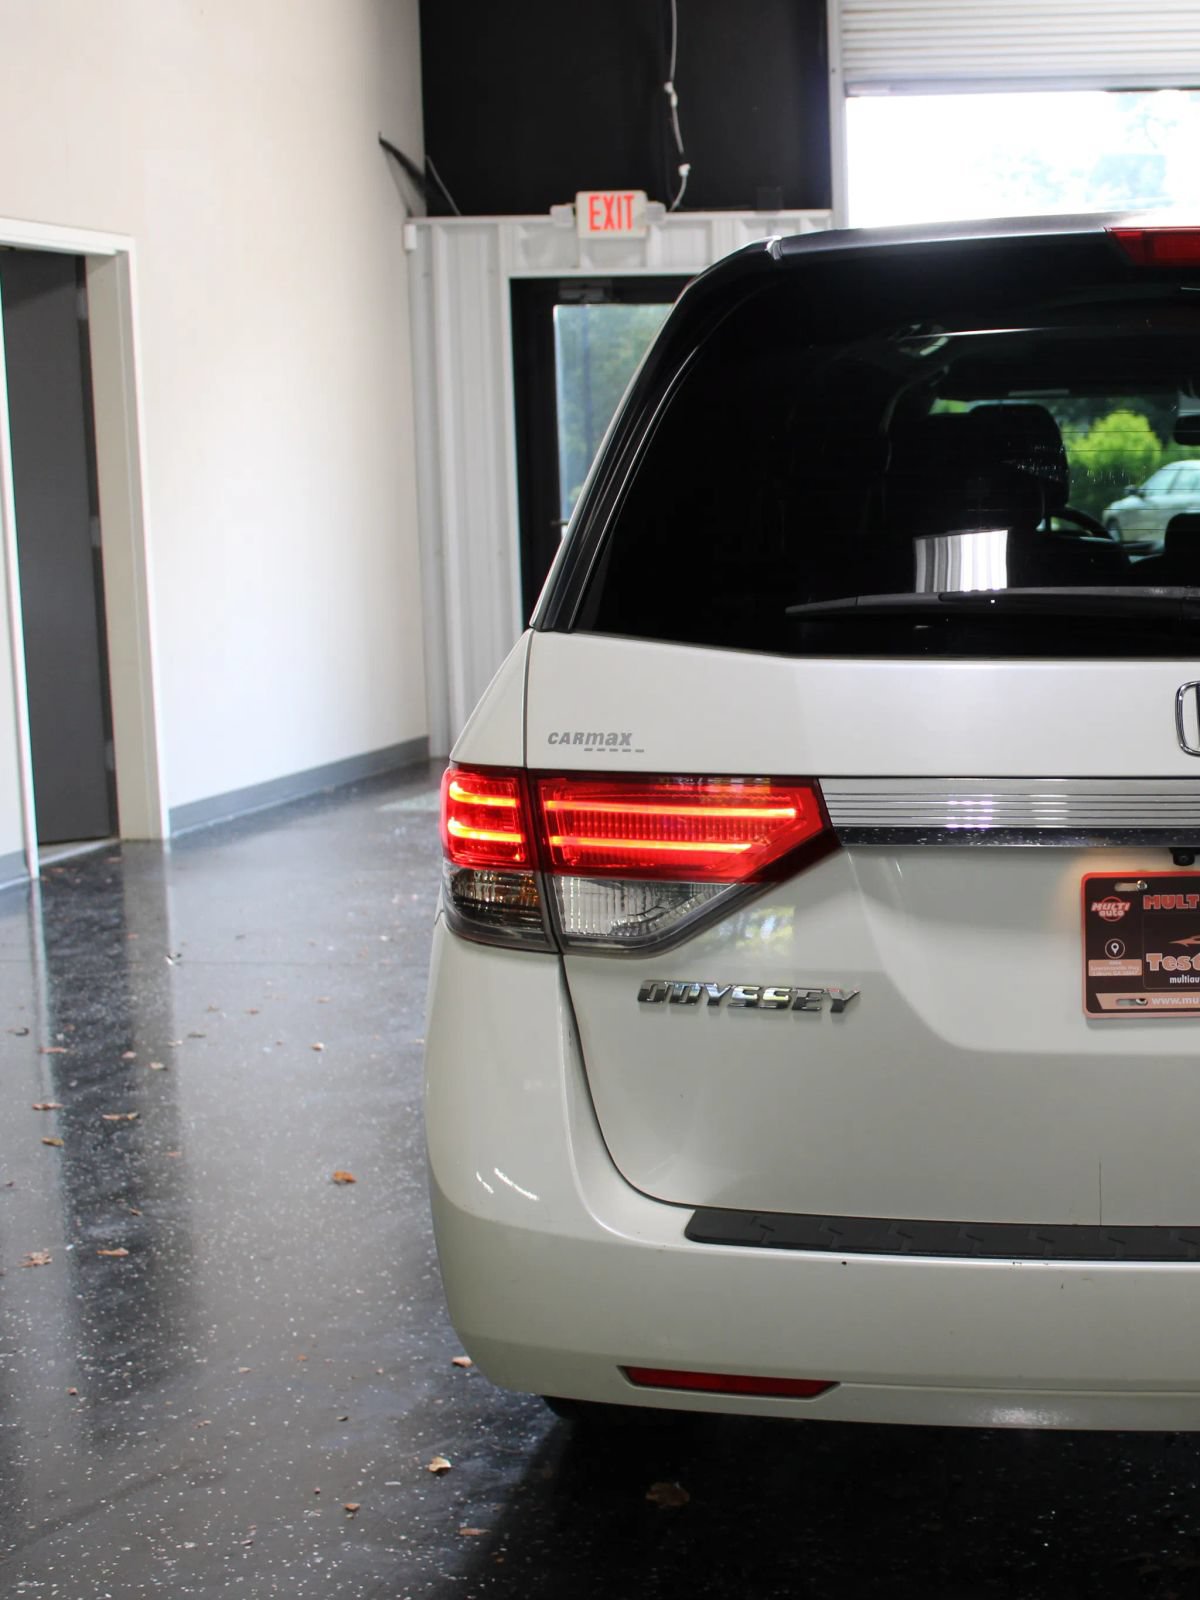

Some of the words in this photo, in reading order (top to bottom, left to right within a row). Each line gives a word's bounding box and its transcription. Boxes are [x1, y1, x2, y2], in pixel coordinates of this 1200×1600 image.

[588, 194, 635, 231] EXIT
[1091, 902, 1131, 911] MULTI
[637, 979, 861, 1013] ODYSSEY
